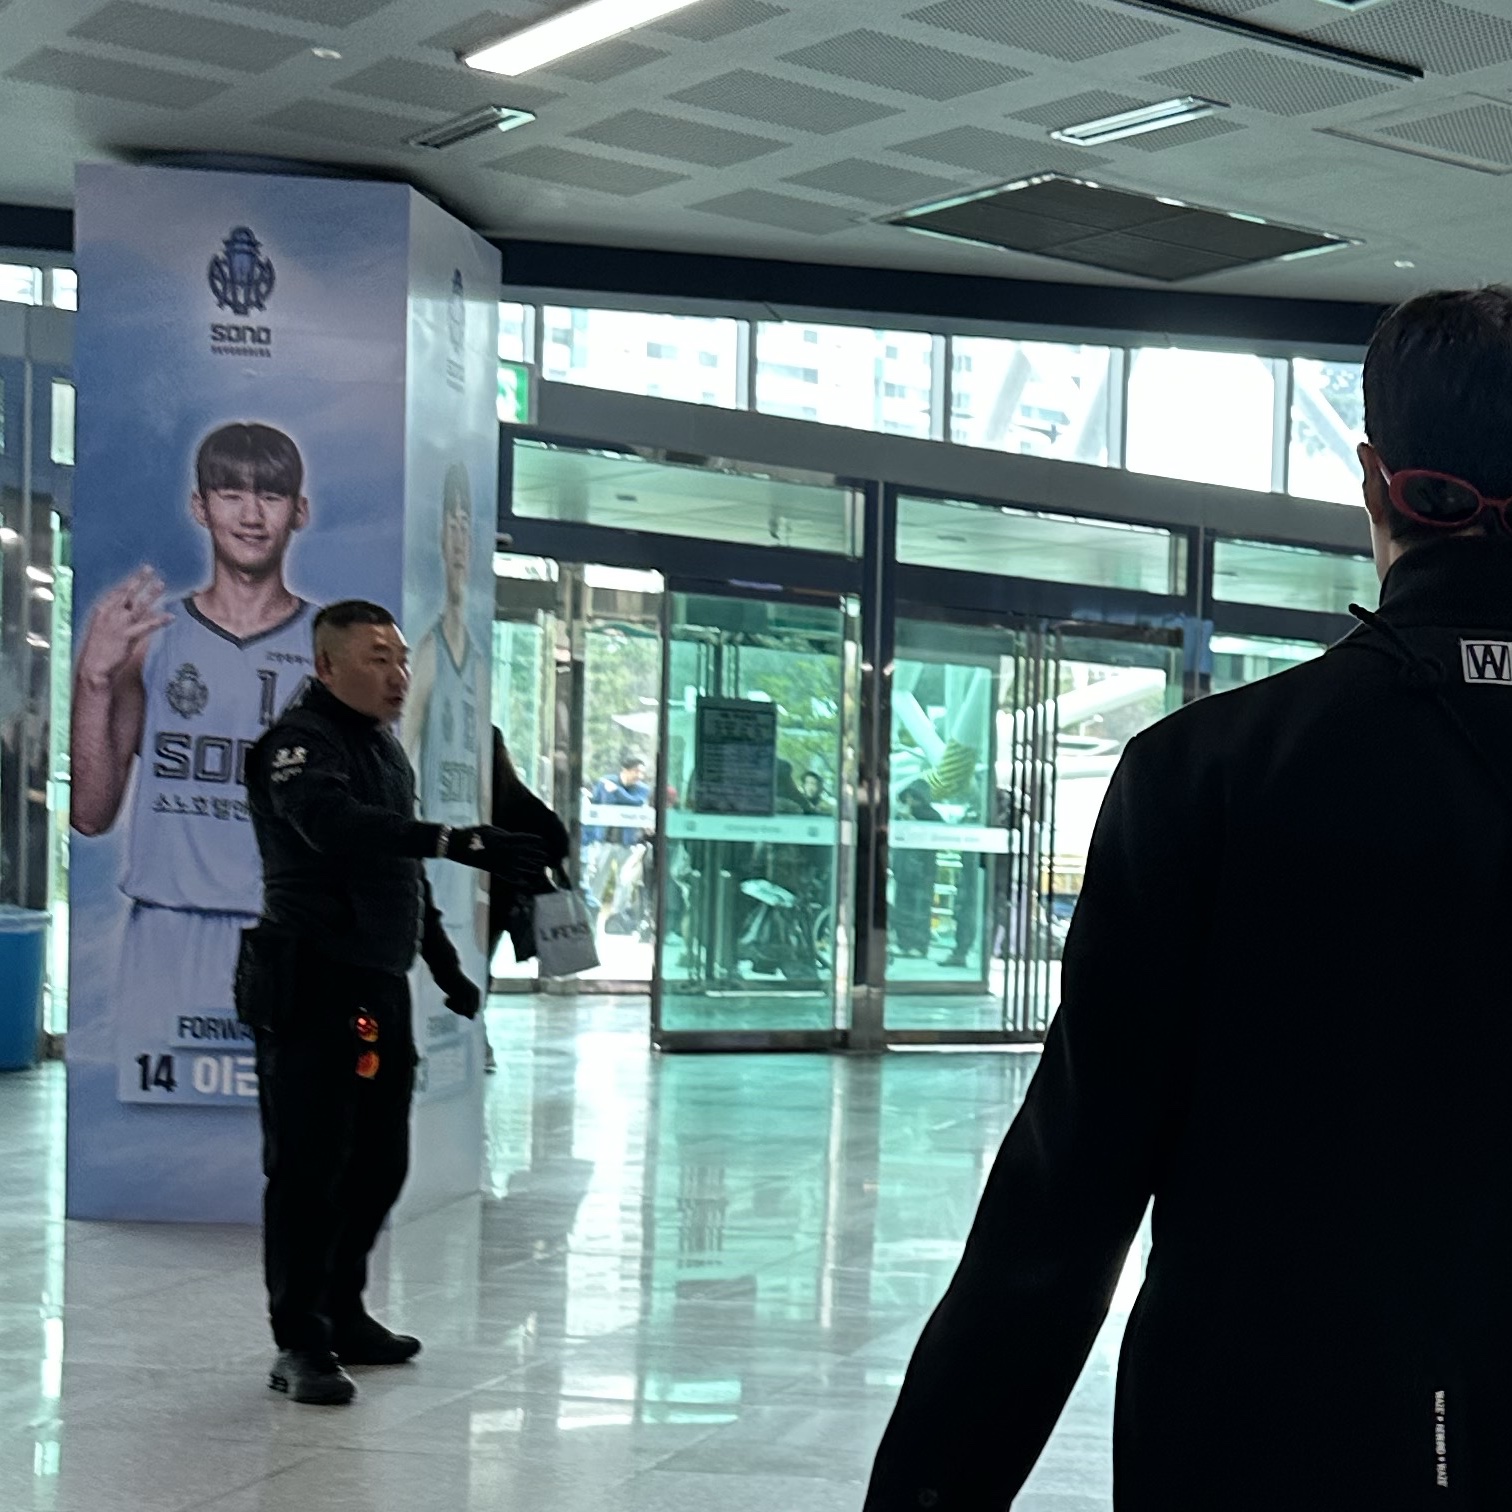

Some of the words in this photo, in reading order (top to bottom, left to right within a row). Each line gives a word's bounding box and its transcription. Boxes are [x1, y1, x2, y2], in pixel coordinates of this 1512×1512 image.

[178, 1015, 256, 1041] FORWA
[135, 1053, 177, 1092] 14
[192, 1055, 259, 1097] 이근
